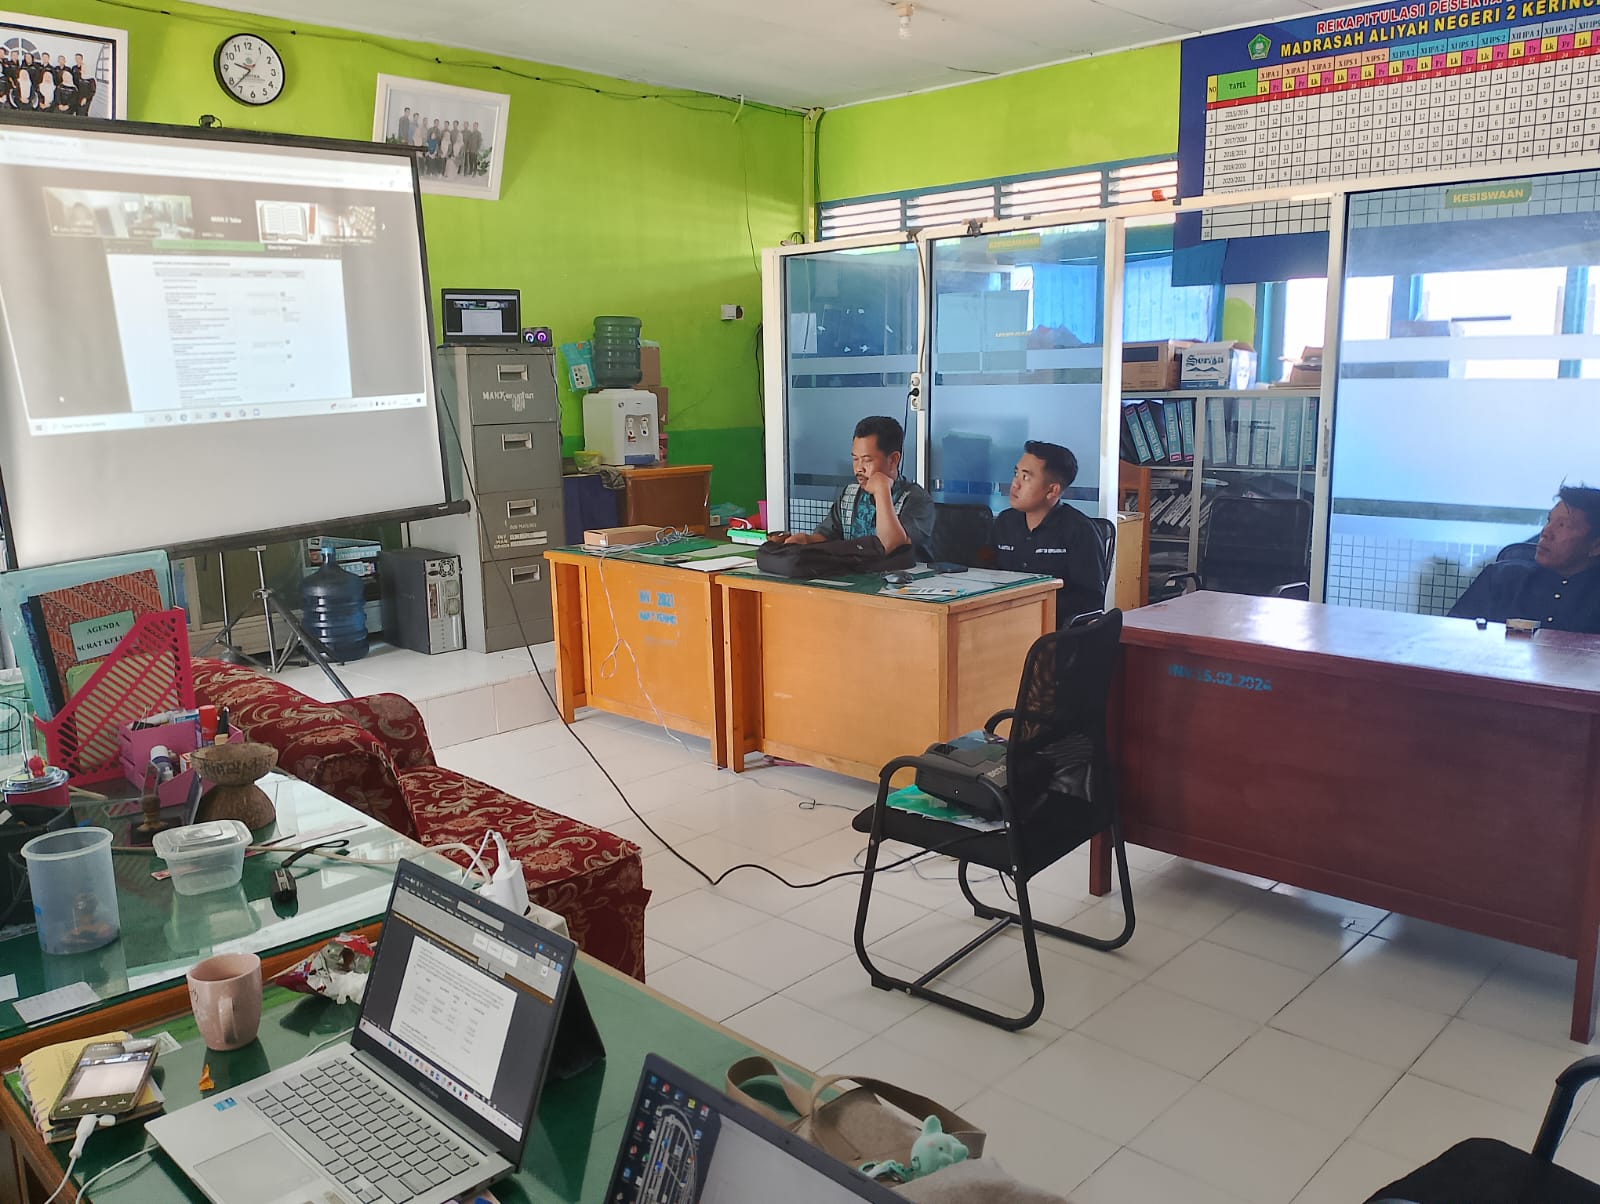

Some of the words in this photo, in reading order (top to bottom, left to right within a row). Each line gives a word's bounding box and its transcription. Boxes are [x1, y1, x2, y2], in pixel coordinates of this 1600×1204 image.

[1317, 4, 1425, 34] REKAPITULASI
[1280, 31, 1364, 57] MADRASAH
[1369, 20, 1429, 43] ALIYAH
[1434, 8, 1500, 32] NEGERI
[1506, 5, 1516, 20] 2
[1522, 0, 1600, 17] KERIN
[233, 44, 241, 53] 11
[244, 42, 252, 50] 12
[225, 52, 235, 61] 10
[266, 56, 272, 64] 2
[223, 64, 229, 72] 9
[270, 68, 276, 77] 3
[228, 77, 235, 86] 8
[268, 81, 274, 89] 4
[238, 86, 243, 94] 7
[262, 88, 268, 96] 5
[1453, 190, 1524, 203] KESISWAAN
[87, 622, 120, 634] AGENDA
[77, 640, 102, 652] SURAT
